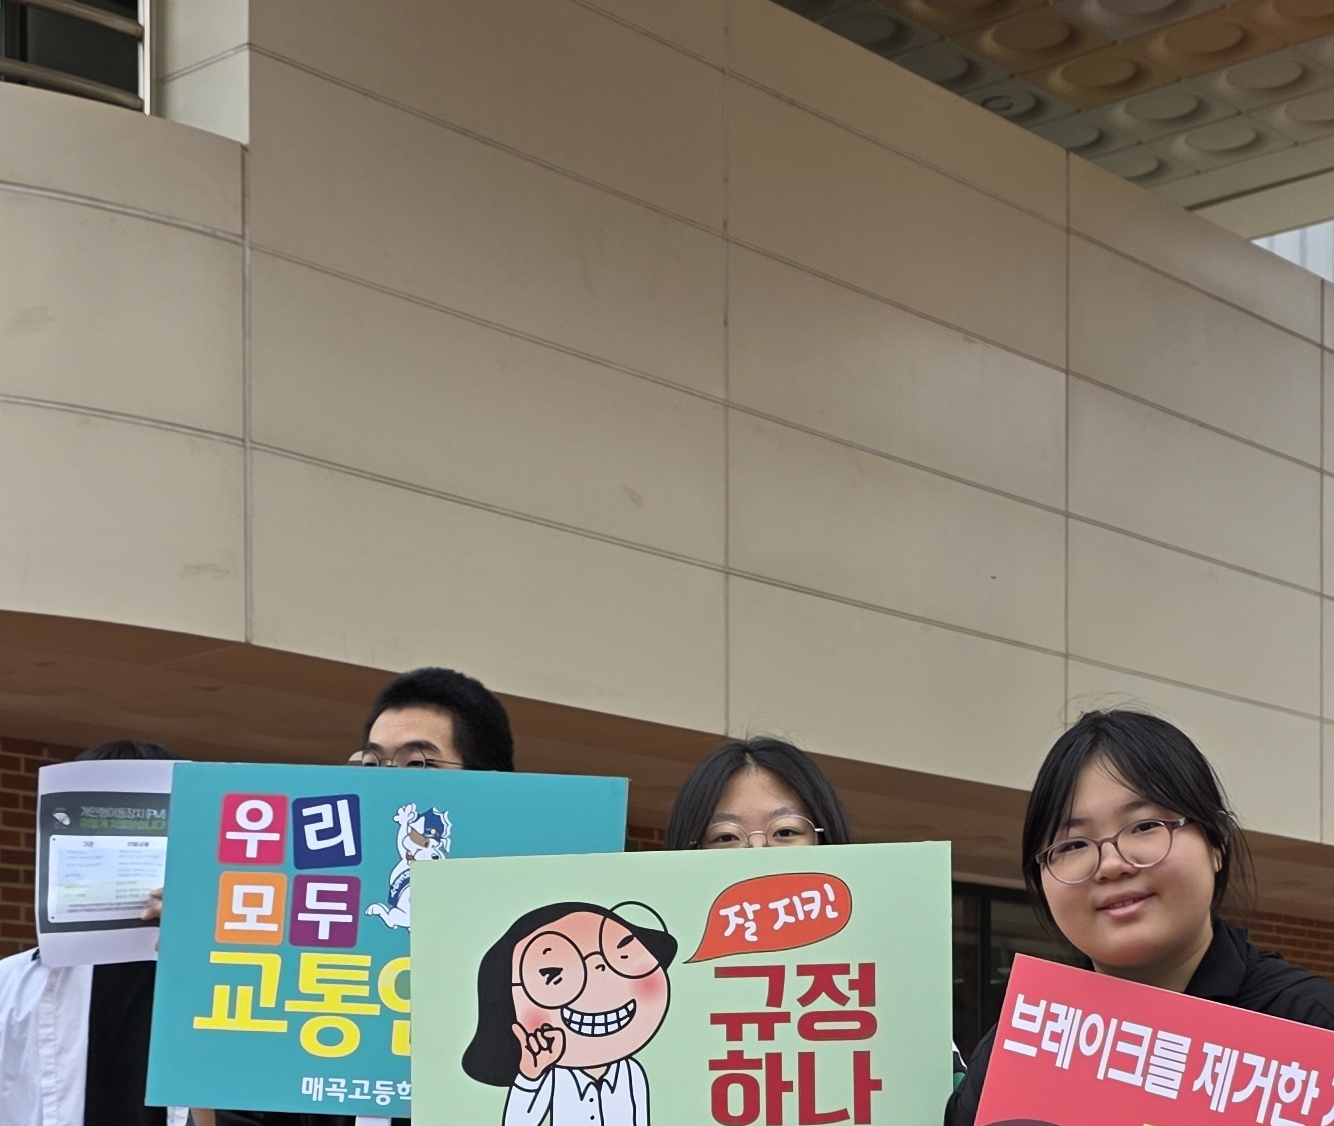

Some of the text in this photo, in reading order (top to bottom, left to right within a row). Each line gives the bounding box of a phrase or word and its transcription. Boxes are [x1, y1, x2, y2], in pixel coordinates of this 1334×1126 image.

[225, 799, 357, 860] 우리
[224, 881, 353, 941] 모두
[718, 883, 840, 942] 잘 지킨
[709, 962, 879, 1042] 규정
[1003, 994, 1192, 1100] 브레이크를
[708, 1050, 883, 1126] 하나
